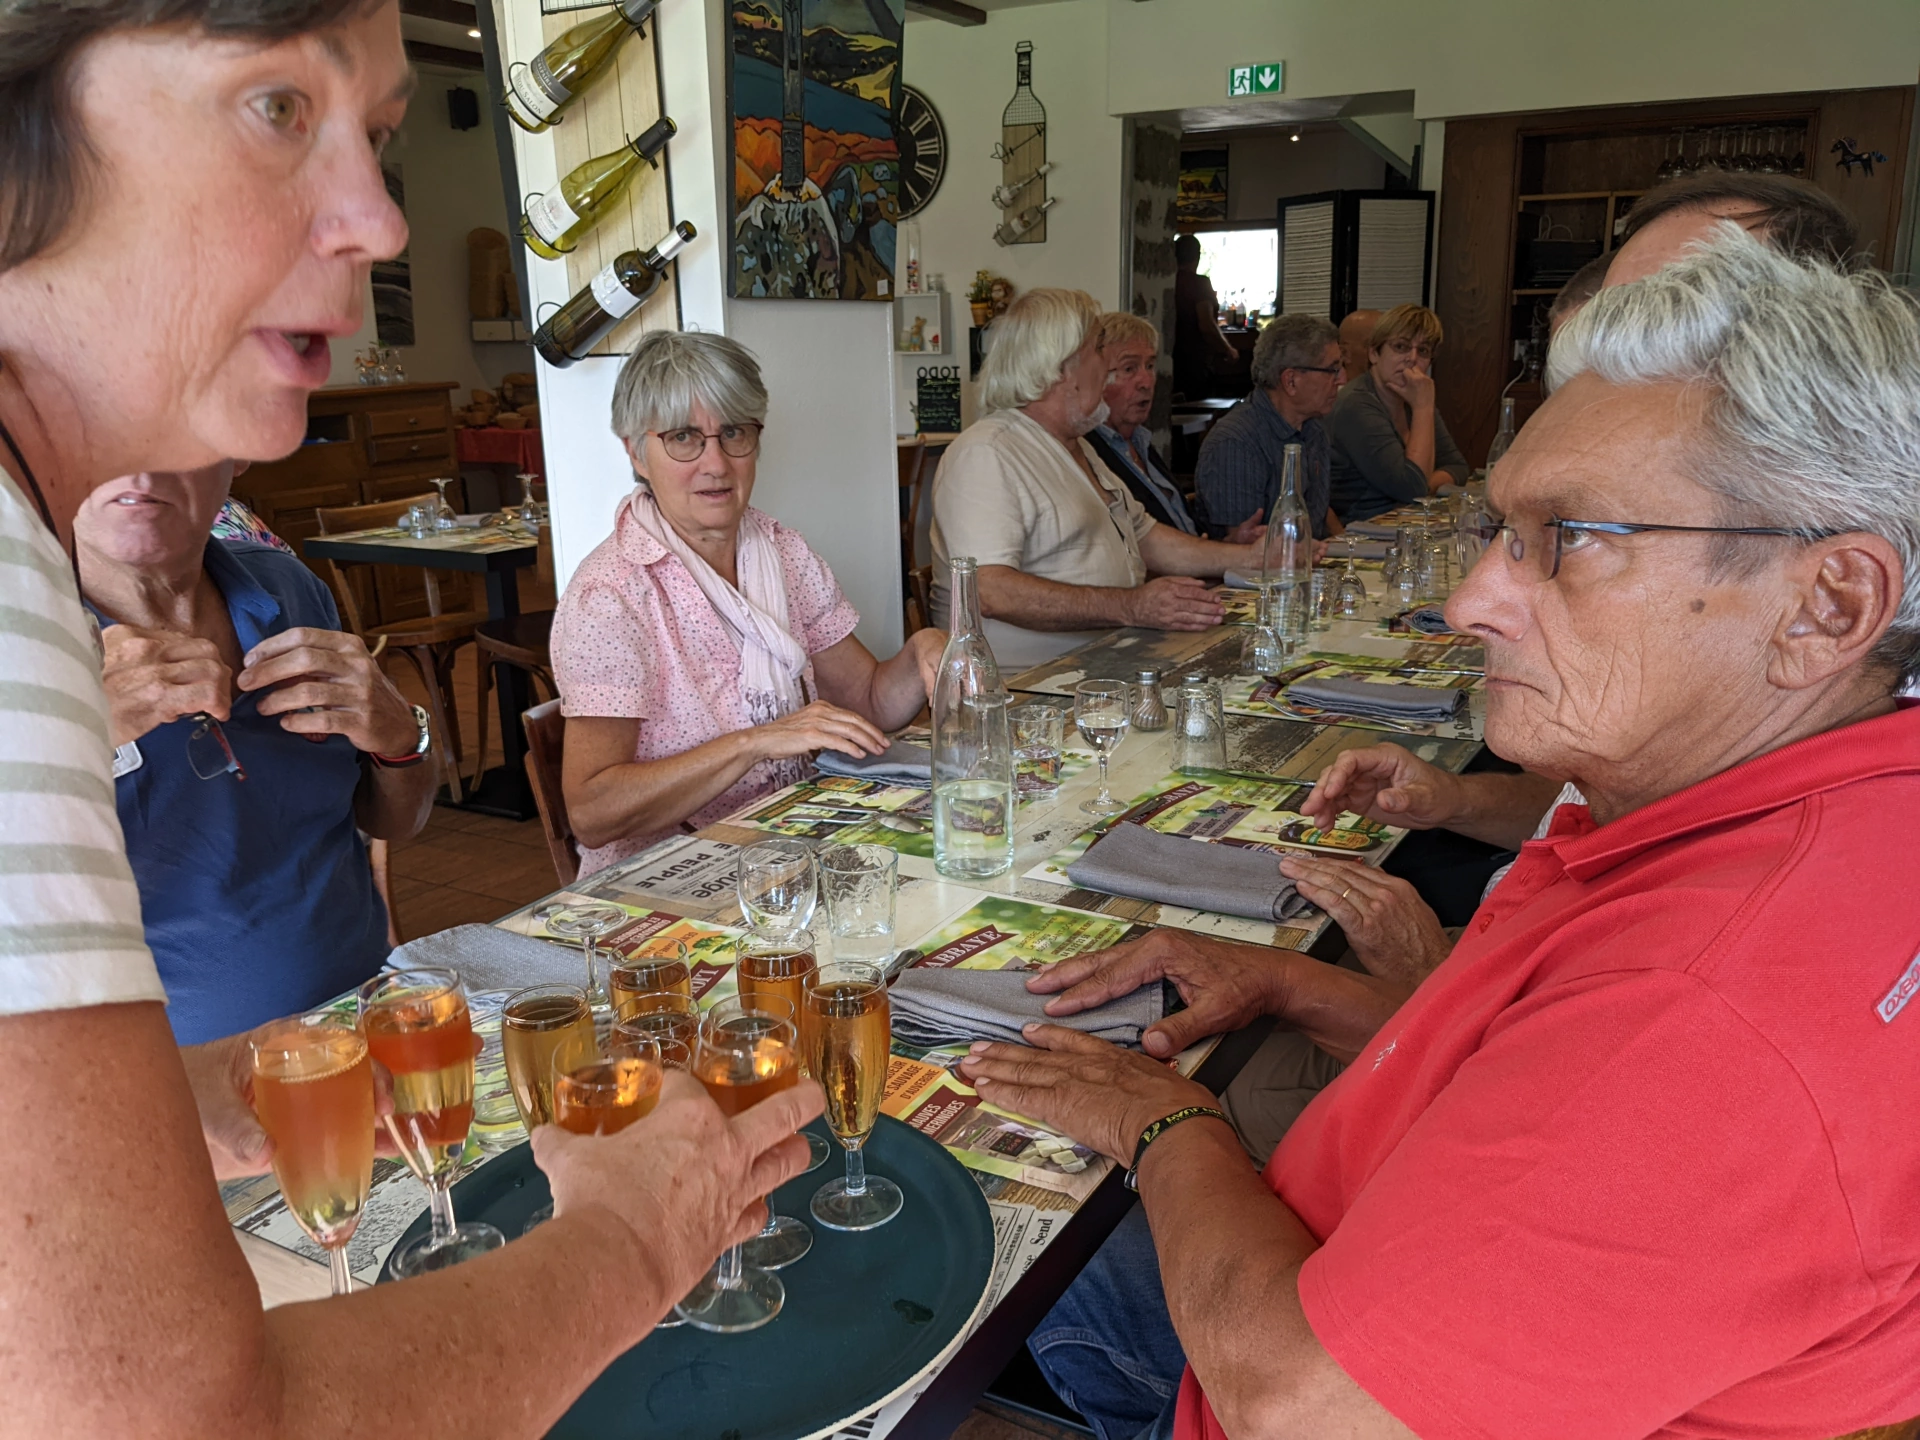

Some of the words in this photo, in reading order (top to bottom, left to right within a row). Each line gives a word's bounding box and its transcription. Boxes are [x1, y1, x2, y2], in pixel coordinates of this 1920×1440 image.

[635, 853, 713, 889] PEUPLE
[887, 1064, 923, 1095] SAUVAGE
[900, 1069, 940, 1100] D'AUVERGNE
[921, 1100, 966, 1135] MERINGUES
[1030, 1218, 1054, 1246] Send
